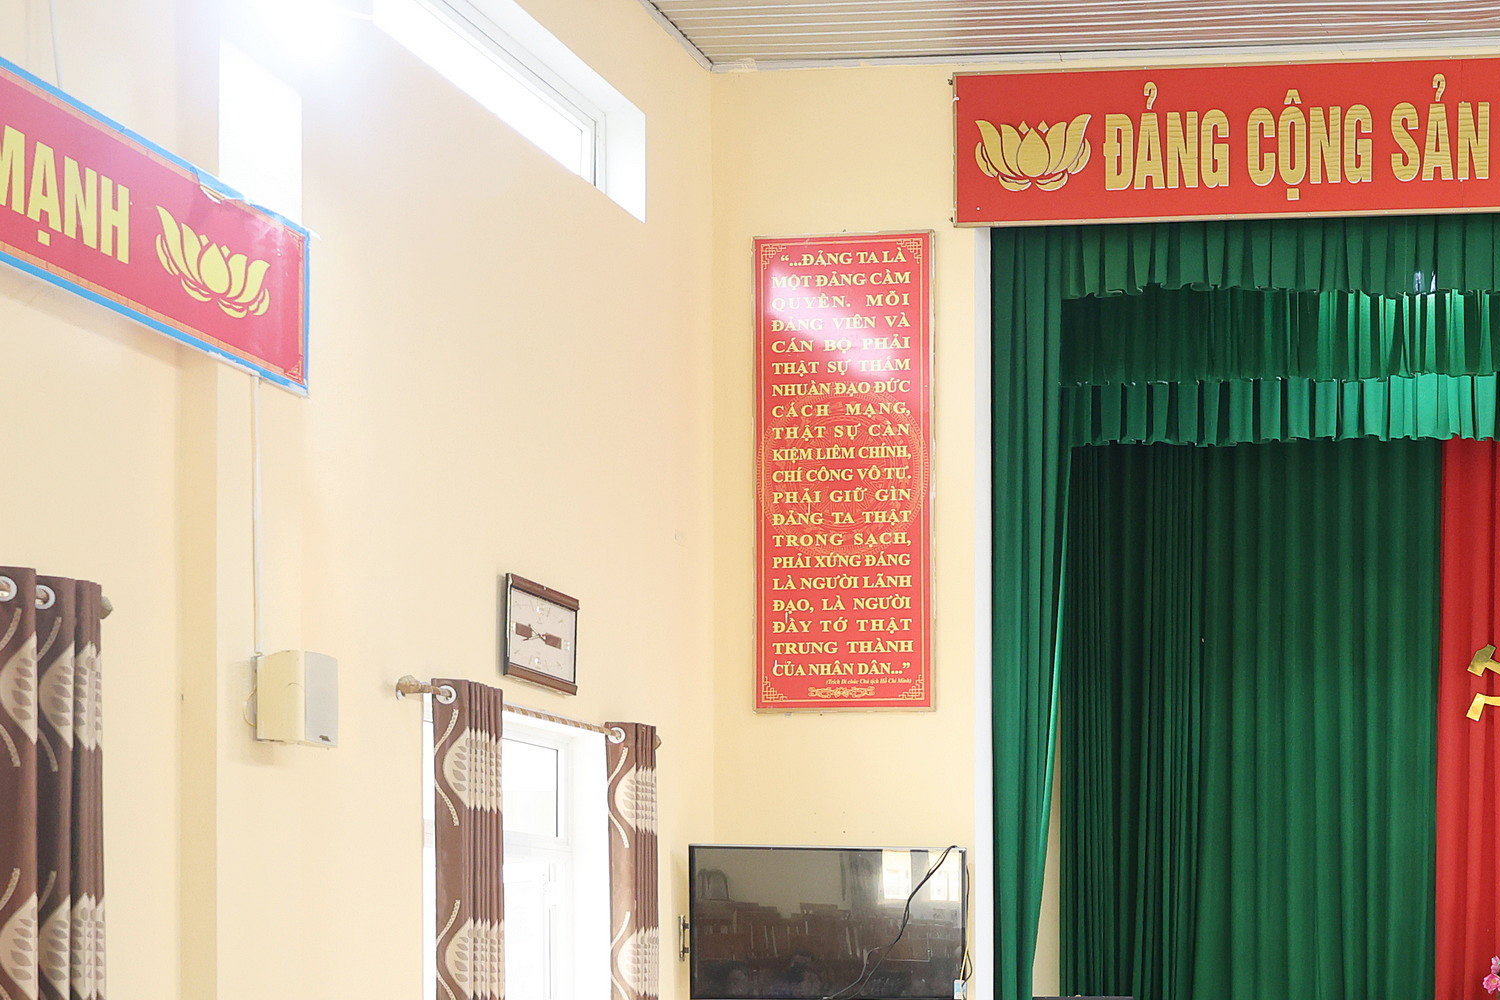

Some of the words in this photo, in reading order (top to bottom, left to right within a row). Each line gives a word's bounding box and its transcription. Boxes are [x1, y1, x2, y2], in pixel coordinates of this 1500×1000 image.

[1104, 81, 1230, 192] ĐẢNG
[1246, 89, 1373, 202] CỘNG
[1391, 73, 1491, 182] SẢN
[856, 252, 881, 263] TA
[882, 248, 907, 263] LÀ
[772, 276, 811, 290] MỘT
[816, 274, 866, 287] ĐẢNG
[870, 272, 910, 285] CẦM
[771, 294, 851, 311] QUYỀN.
[866, 291, 909, 306] MỖI
[832, 314, 876, 329] VIÊN
[885, 312, 910, 327] VÀ
[771, 337, 814, 353] CÁN
[824, 338, 851, 353] BỘ
[862, 334, 910, 349] PHẢI
[772, 360, 819, 376] THẬT
[827, 360, 851, 375] SỰ
[772, 381, 831, 396] NHUẦN
[835, 381, 870, 396] ĐẠO
[875, 378, 911, 393] ĐỨC
[772, 401, 829, 417] CÁCH
[846, 402, 910, 417] MẠNG,
[773, 426, 825, 441] THẬT
[834, 424, 860, 440] SỰ
[868, 422, 910, 436] CẦN
[773, 448, 812, 463] KIỆM
[816, 445, 855, 460] LIÊM
[858, 442, 911, 459] CHÍNH,
[772, 467, 802, 482] CHÍ
[806, 467, 853, 481] CÔNG
[857, 466, 881, 480] VÔ
[885, 467, 912, 479] TƯ.
[773, 488, 821, 504] PHẢI
[829, 487, 867, 502] GIỮ
[874, 488, 911, 501] GÌN
[773, 510, 824, 525] ĐẢNG
[832, 512, 854, 524] TA
[862, 510, 911, 525] THẬT
[773, 534, 843, 546] TRONG
[853, 532, 912, 548] SẠCH,
[773, 553, 812, 568] PHẢI
[814, 552, 861, 567] XỨNG
[865, 551, 910, 567] ĐÁNG
[773, 575, 796, 590] LÀ
[800, 574, 858, 589] NGƯỜI
[863, 573, 912, 588] LÃNH
[773, 599, 814, 613] ĐẠO,
[822, 595, 845, 610] LÀ
[853, 594, 911, 609] NGƯỜI
[820, 618, 848, 632] TỚ
[856, 618, 912, 634] THẬT
[773, 641, 839, 654] TRUNG
[847, 638, 914, 653] THÀNH
[773, 661, 806, 676] CỦA
[808, 660, 853, 675] NHÂN
